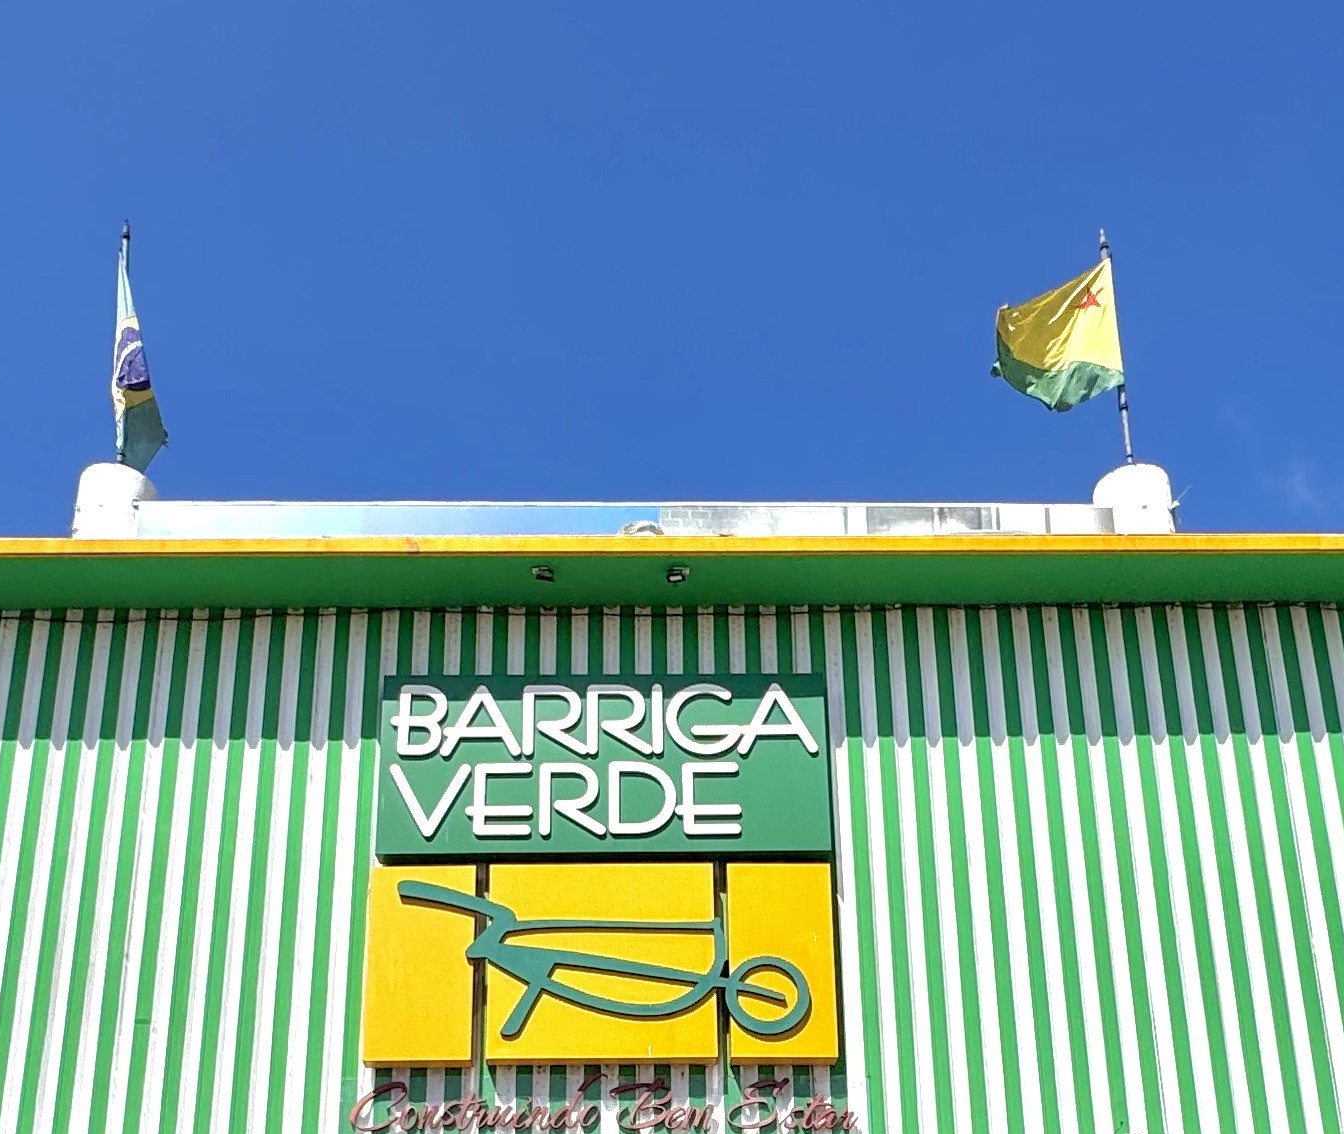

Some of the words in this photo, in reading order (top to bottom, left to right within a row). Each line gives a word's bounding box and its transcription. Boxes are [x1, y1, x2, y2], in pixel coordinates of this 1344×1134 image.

[389, 682, 820, 758] BARRIGA
[389, 761, 743, 839] VERDE
[349, 1073, 607, 1133] Construindo
[609, 1078, 715, 1133] Bem
[727, 1078, 860, 1133] Estar
